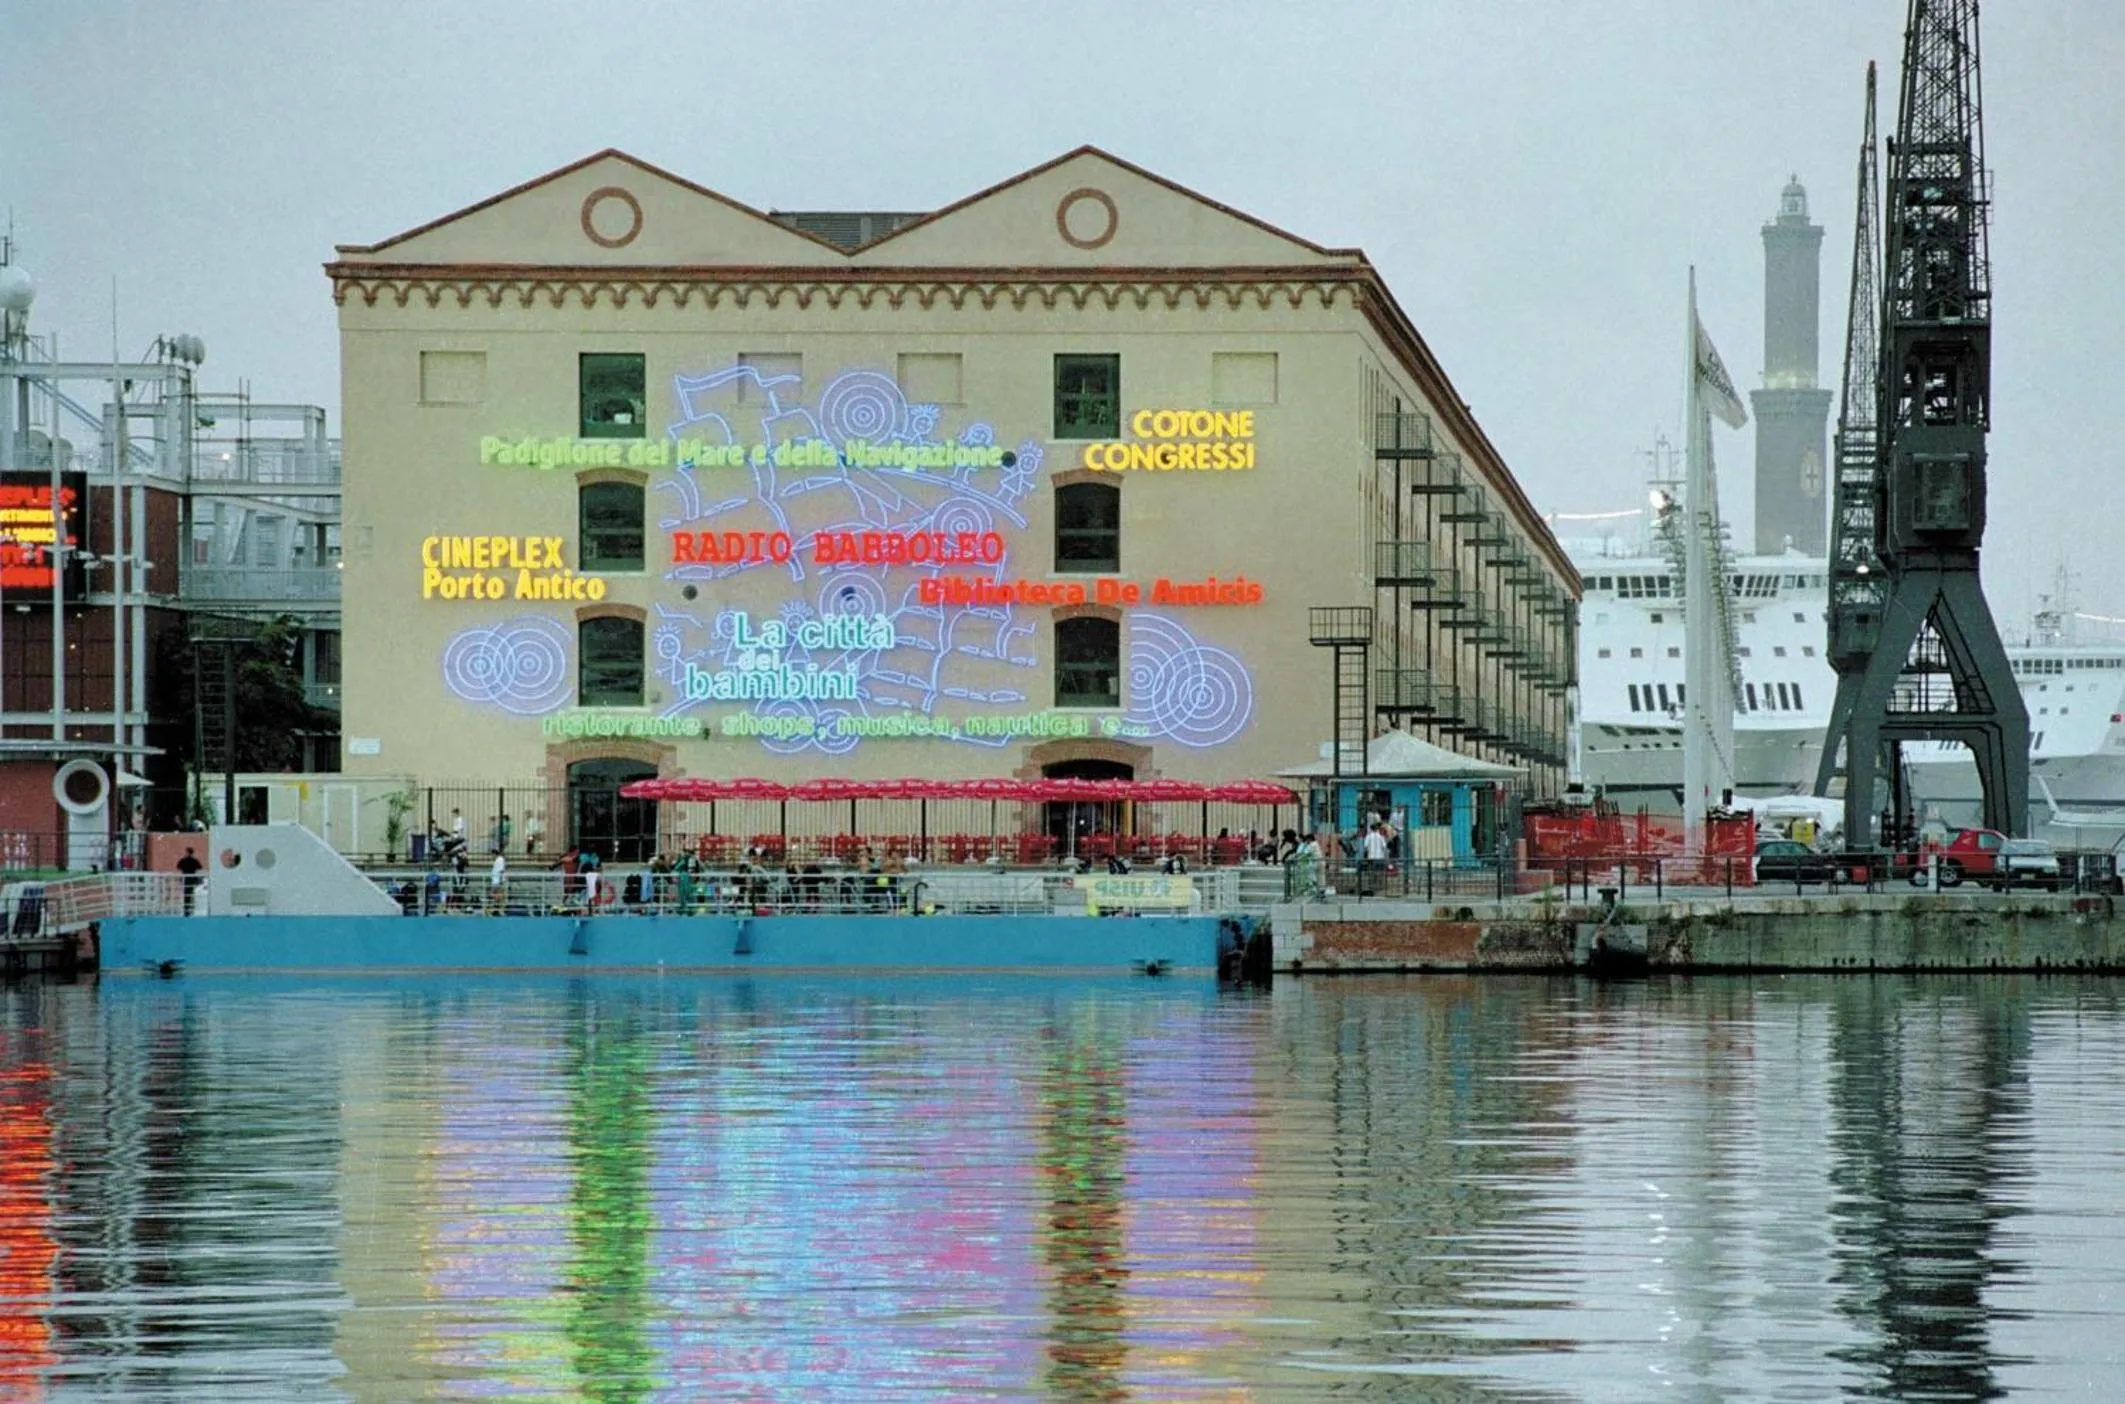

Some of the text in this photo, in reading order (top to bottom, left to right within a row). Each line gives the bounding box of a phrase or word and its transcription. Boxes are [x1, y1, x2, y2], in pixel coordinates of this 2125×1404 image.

[1133, 409, 1255, 438] COTONE
[480, 436, 1001, 473] Padiglione del Mare e della Navigazione
[1084, 442, 1255, 471] CONGRESSI
[422, 536, 564, 568] CINEPLEX
[671, 531, 1005, 564] RADIO BABBOLEO
[423, 567, 606, 600] Porto Antico
[920, 577, 1264, 606] Biblioteca De Amicis
[735, 611, 896, 650] La città
[738, 649, 782, 671] dei
[684, 662, 858, 699] bambini
[720, 711, 827, 740] shops,
[835, 711, 961, 740] musica,
[965, 711, 1089, 736] nautica
